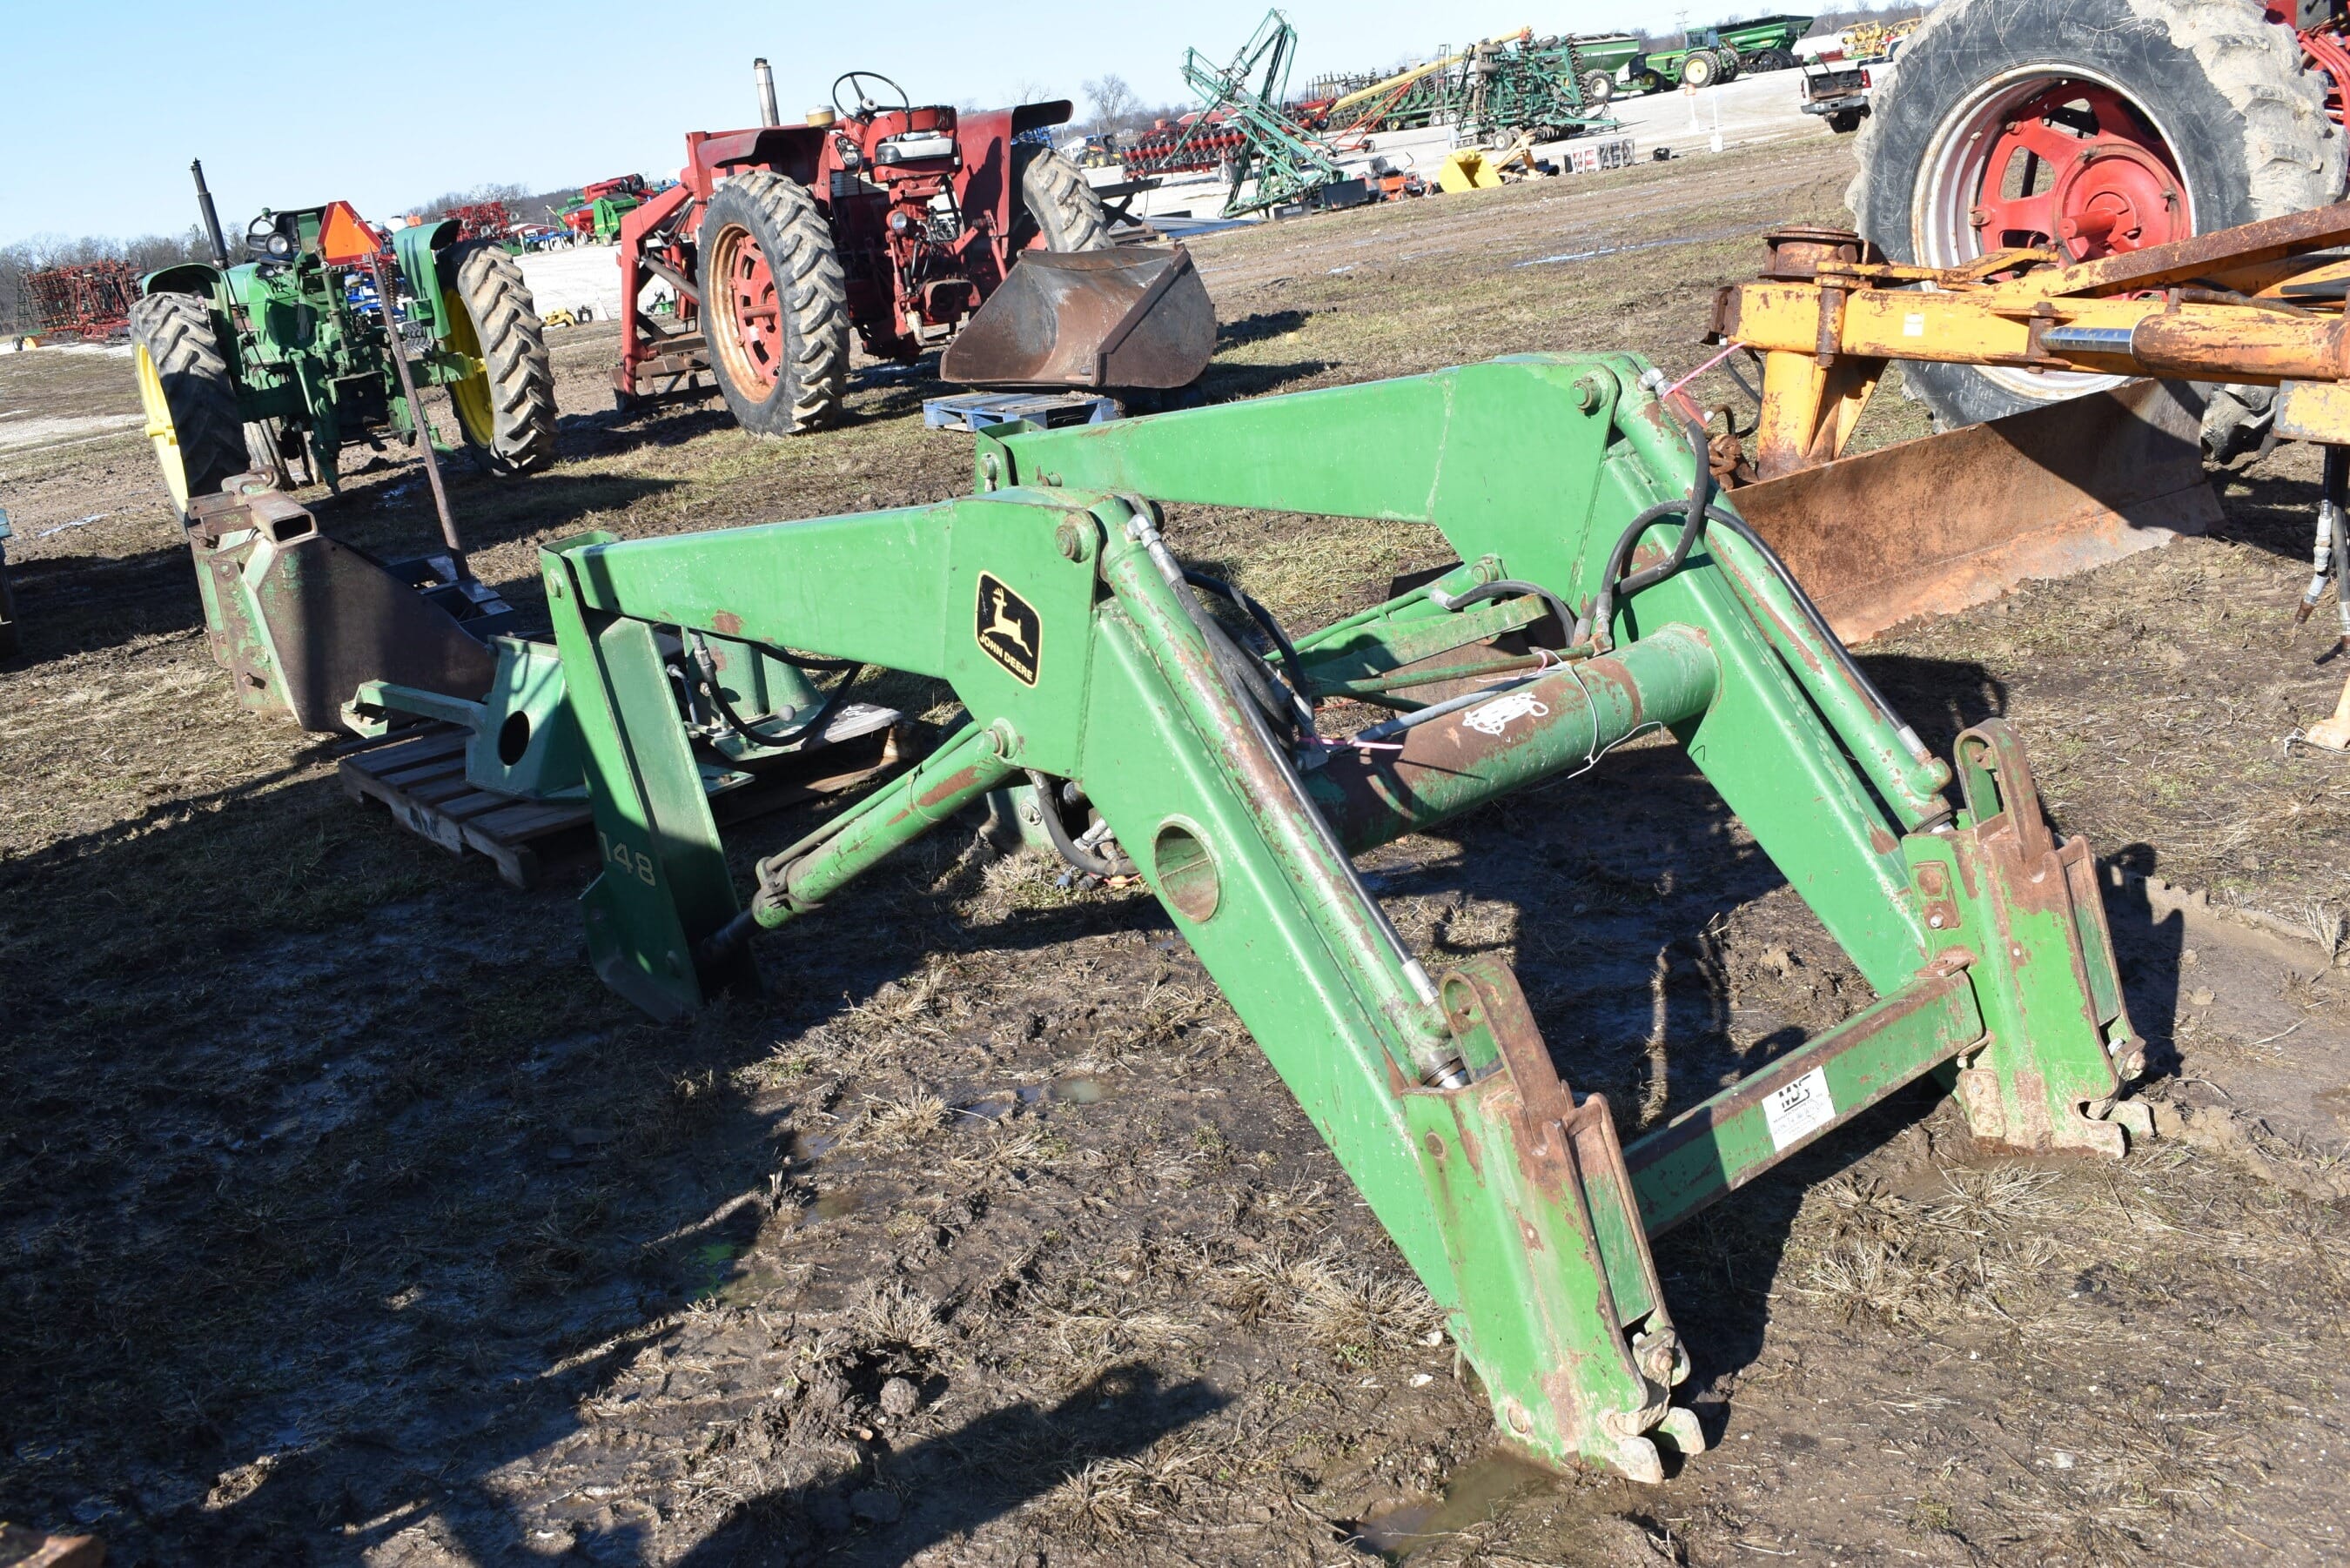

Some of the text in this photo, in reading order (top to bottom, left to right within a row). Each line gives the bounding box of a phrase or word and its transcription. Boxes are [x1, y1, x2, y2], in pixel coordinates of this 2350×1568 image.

[979, 633, 1033, 681] JOHN DEERE
[599, 831, 656, 887] 148
